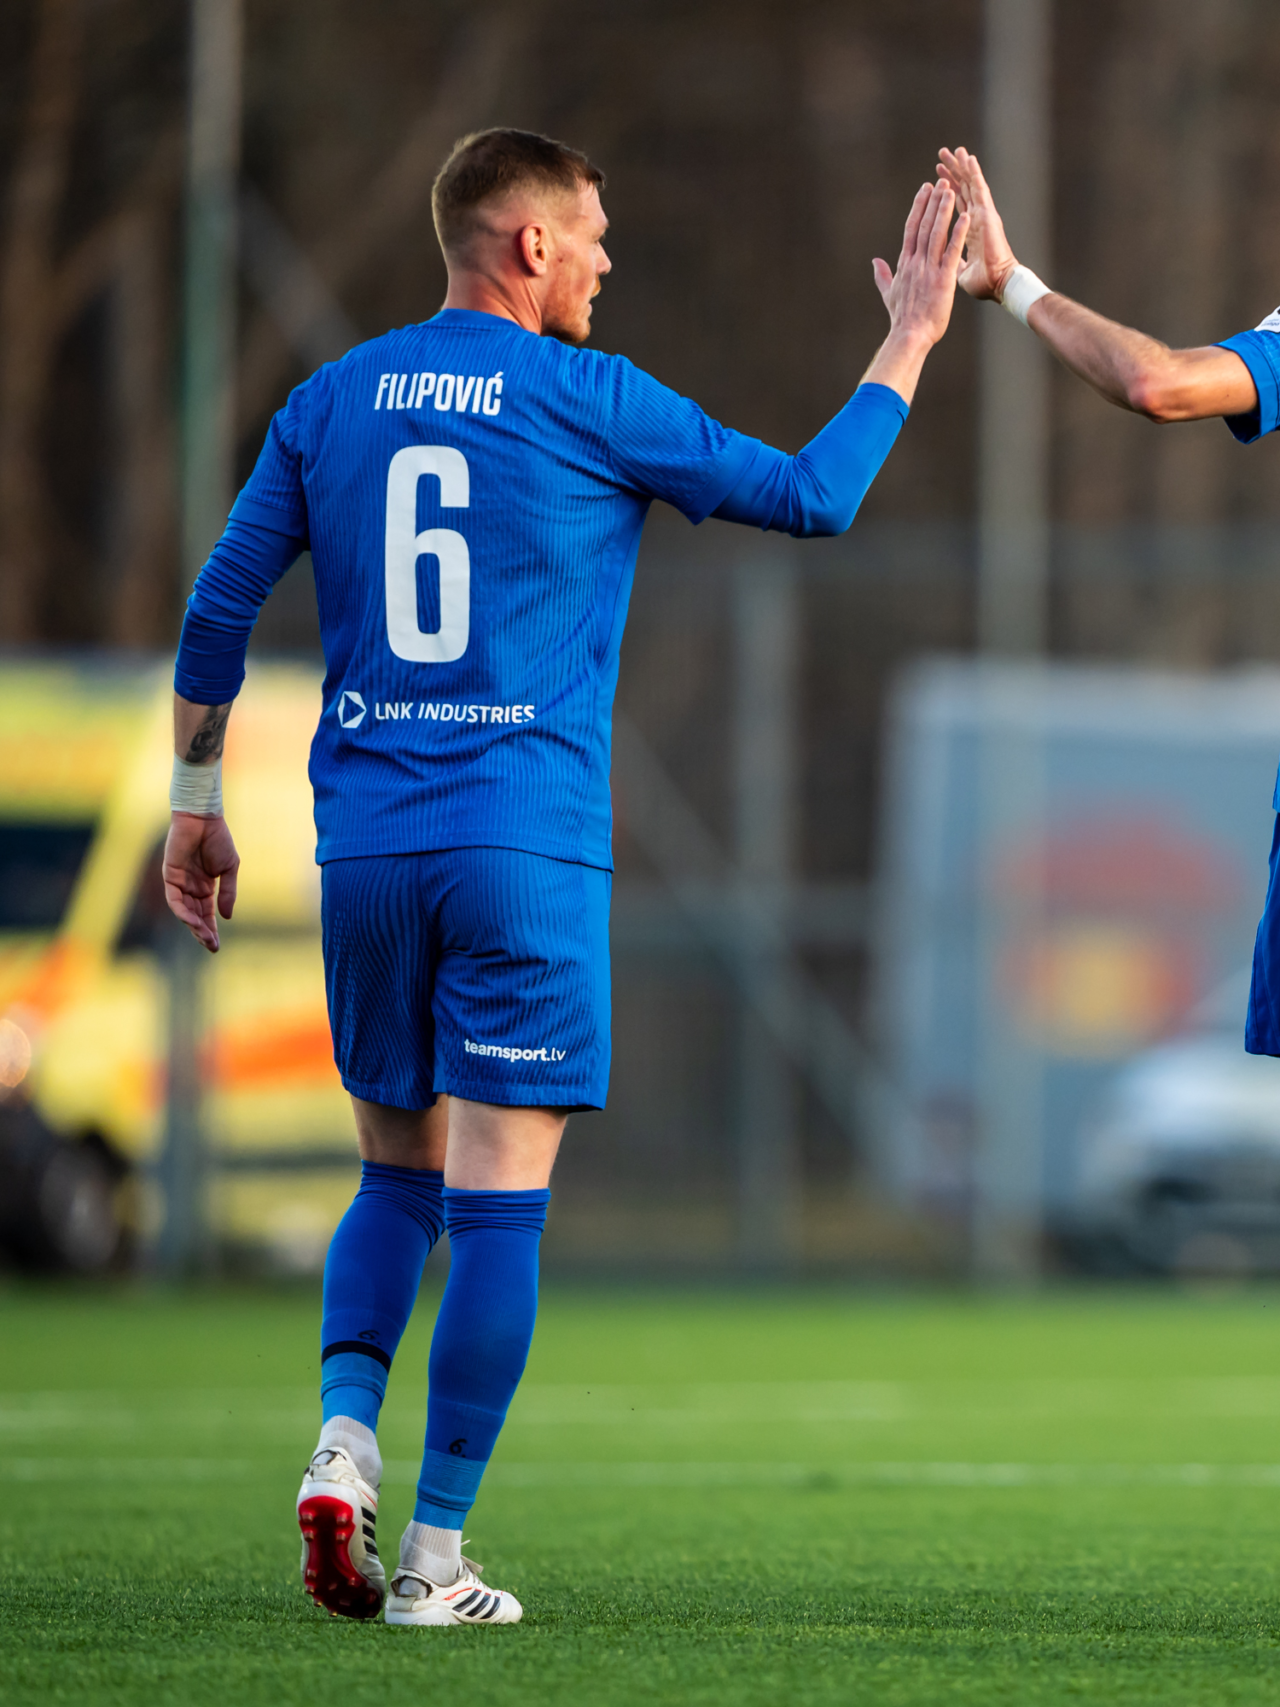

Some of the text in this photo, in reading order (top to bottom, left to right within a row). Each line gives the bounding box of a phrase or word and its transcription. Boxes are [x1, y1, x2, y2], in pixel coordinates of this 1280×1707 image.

[374, 371, 504, 416] FILIPOVIĆ
[385, 445, 471, 663] 6
[375, 702, 535, 723] LNK INDUSTRIES
[464, 1039, 566, 1063] teamsport.lv
